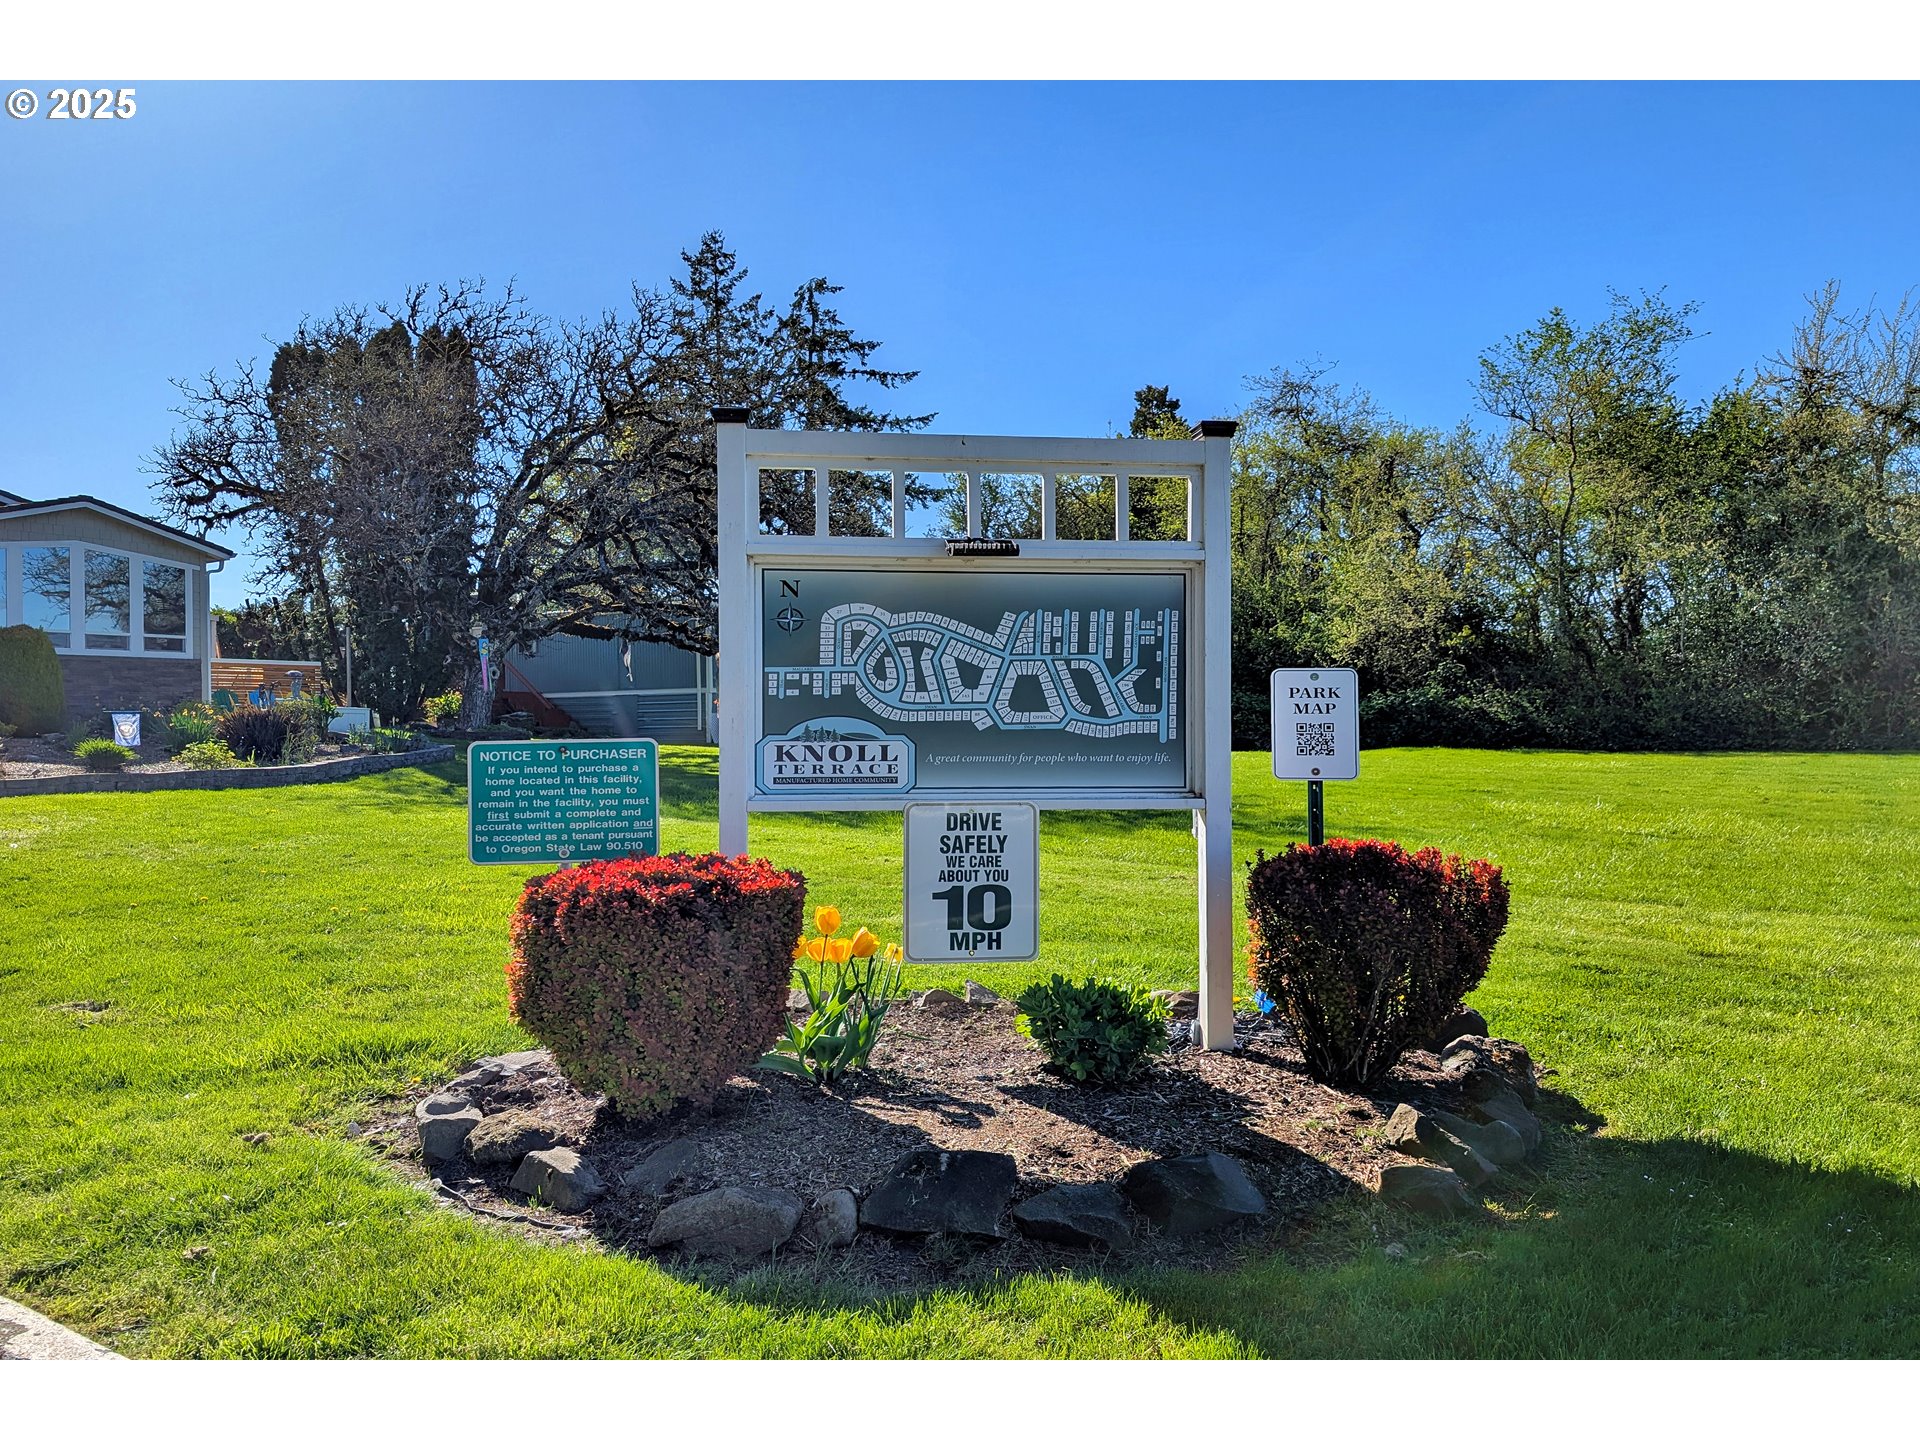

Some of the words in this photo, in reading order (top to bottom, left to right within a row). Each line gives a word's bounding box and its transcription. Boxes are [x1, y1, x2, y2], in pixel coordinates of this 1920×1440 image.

[779, 580, 800, 598] N
[1288, 687, 1341, 698] PARK
[1293, 703, 1336, 714] MAP
[480, 751, 531, 762] NOTICE
[537, 750, 555, 761] TO
[562, 749, 647, 760] PURCHASER
[774, 744, 898, 762] KNOLL
[926, 753, 934, 762] A
[935, 754, 960, 765] great
[962, 753, 1018, 765] community
[1016, 752, 1032, 765] for
[1035, 753, 1065, 765] people
[1067, 753, 1087, 762] who
[1089, 754, 1113, 762] want
[1127, 754, 1152, 765] enjoy
[1154, 752, 1171, 764] life.
[488, 766, 495, 774] If
[500, 767, 519, 775] you
[524, 765, 557, 774] intend
[562, 765, 573, 773] to
[578, 764, 628, 774] purchase
[774, 764, 898, 774] TERRACE
[485, 778, 515, 786] home
[520, 776, 560, 785] located
[565, 776, 574, 784] in
[579, 775, 598, 784] this
[603, 774, 642, 784] facility,
[491, 789, 510, 797] and
[515, 789, 535, 798] you
[539, 788, 564, 796] want
[570, 787, 586, 795] the
[591, 786, 621, 795] home
[626, 786, 637, 794] to
[478, 800, 515, 808] remain
[519, 799, 528, 807] in
[533, 798, 550, 807] the
[555, 798, 594, 808] facility,
[623, 796, 650, 805] must
[487, 812, 509, 821] first
[514, 811, 550, 819] submit
[566, 810, 616, 820] complete
[621, 808, 641, 816] and
[475, 822, 523, 831] accurate
[527, 821, 565, 830] written
[569, 820, 628, 830] application
[633, 819, 653, 830] and
[946, 812, 1001, 831] DRIVE
[475, 834, 488, 842] be
[493, 833, 541, 843] accepted
[572, 831, 604, 840] tenant
[608, 831, 653, 841] pursuant
[486, 845, 497, 853] to
[502, 844, 542, 855] Oregon
[546, 843, 575, 852] State
[580, 842, 601, 851] Law
[606, 842, 643, 850] 90.510
[940, 835, 1008, 854] SAFELY
[946, 856, 965, 868] WE
[970, 856, 1001, 868] CARE
[938, 870, 979, 882] ABOUT
[984, 870, 1009, 882] YOU
[932, 884, 1012, 931] 10
[950, 932, 1001, 950] MPH
